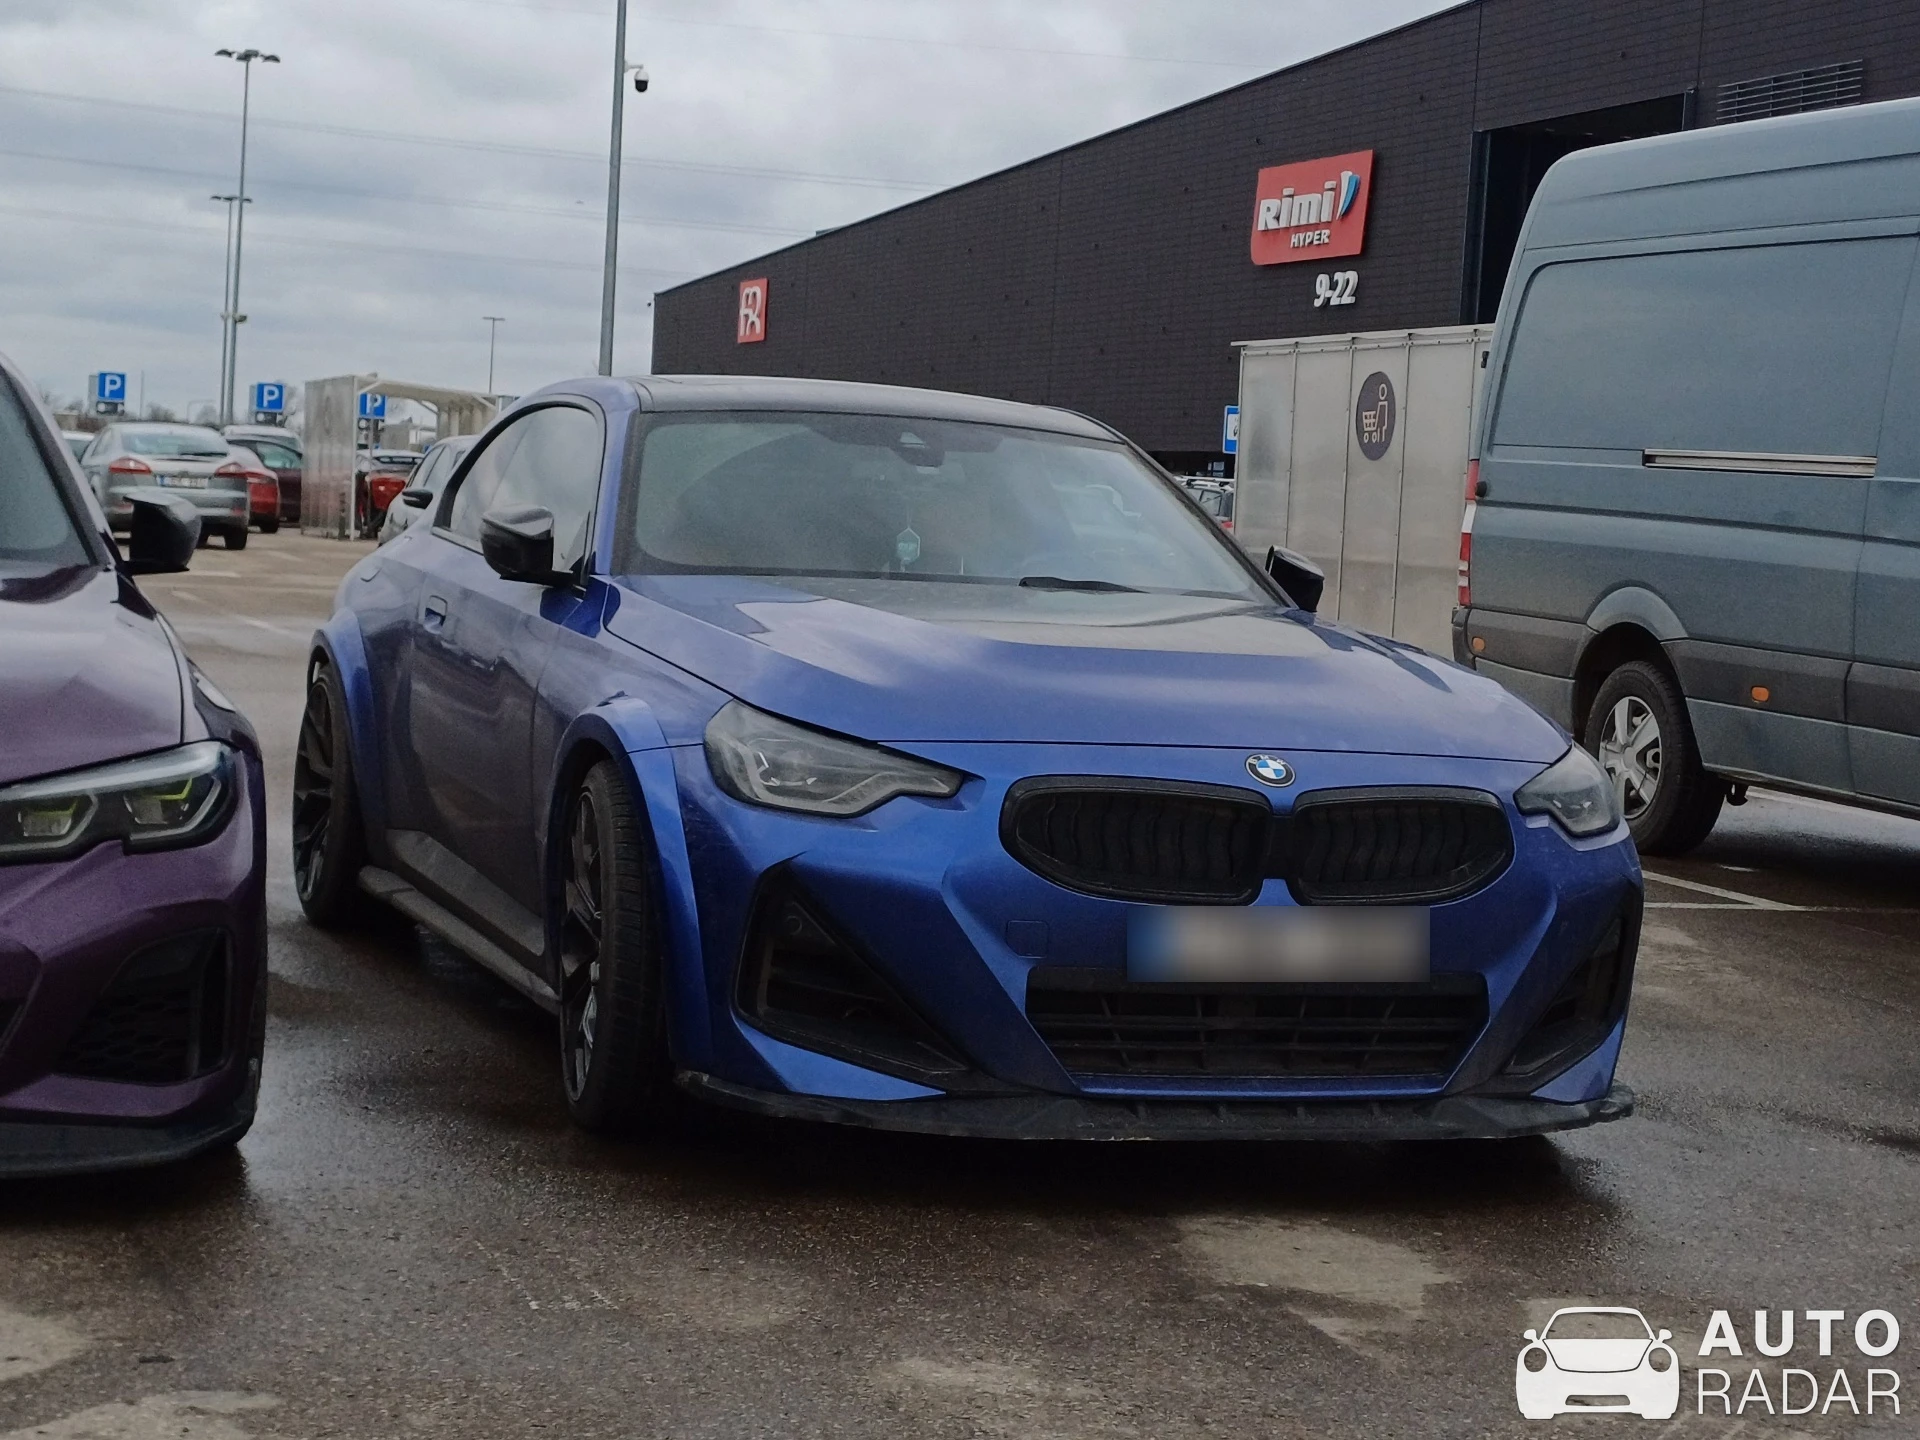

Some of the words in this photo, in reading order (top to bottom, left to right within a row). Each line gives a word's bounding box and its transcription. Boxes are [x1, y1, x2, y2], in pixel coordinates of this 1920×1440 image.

[1258, 181, 1336, 231] Rimi
[1290, 229, 1331, 248] HYPER
[1314, 270, 1359, 308] 9-22
[105, 374, 122, 398] P
[263, 385, 280, 408] P
[366, 393, 382, 414] P
